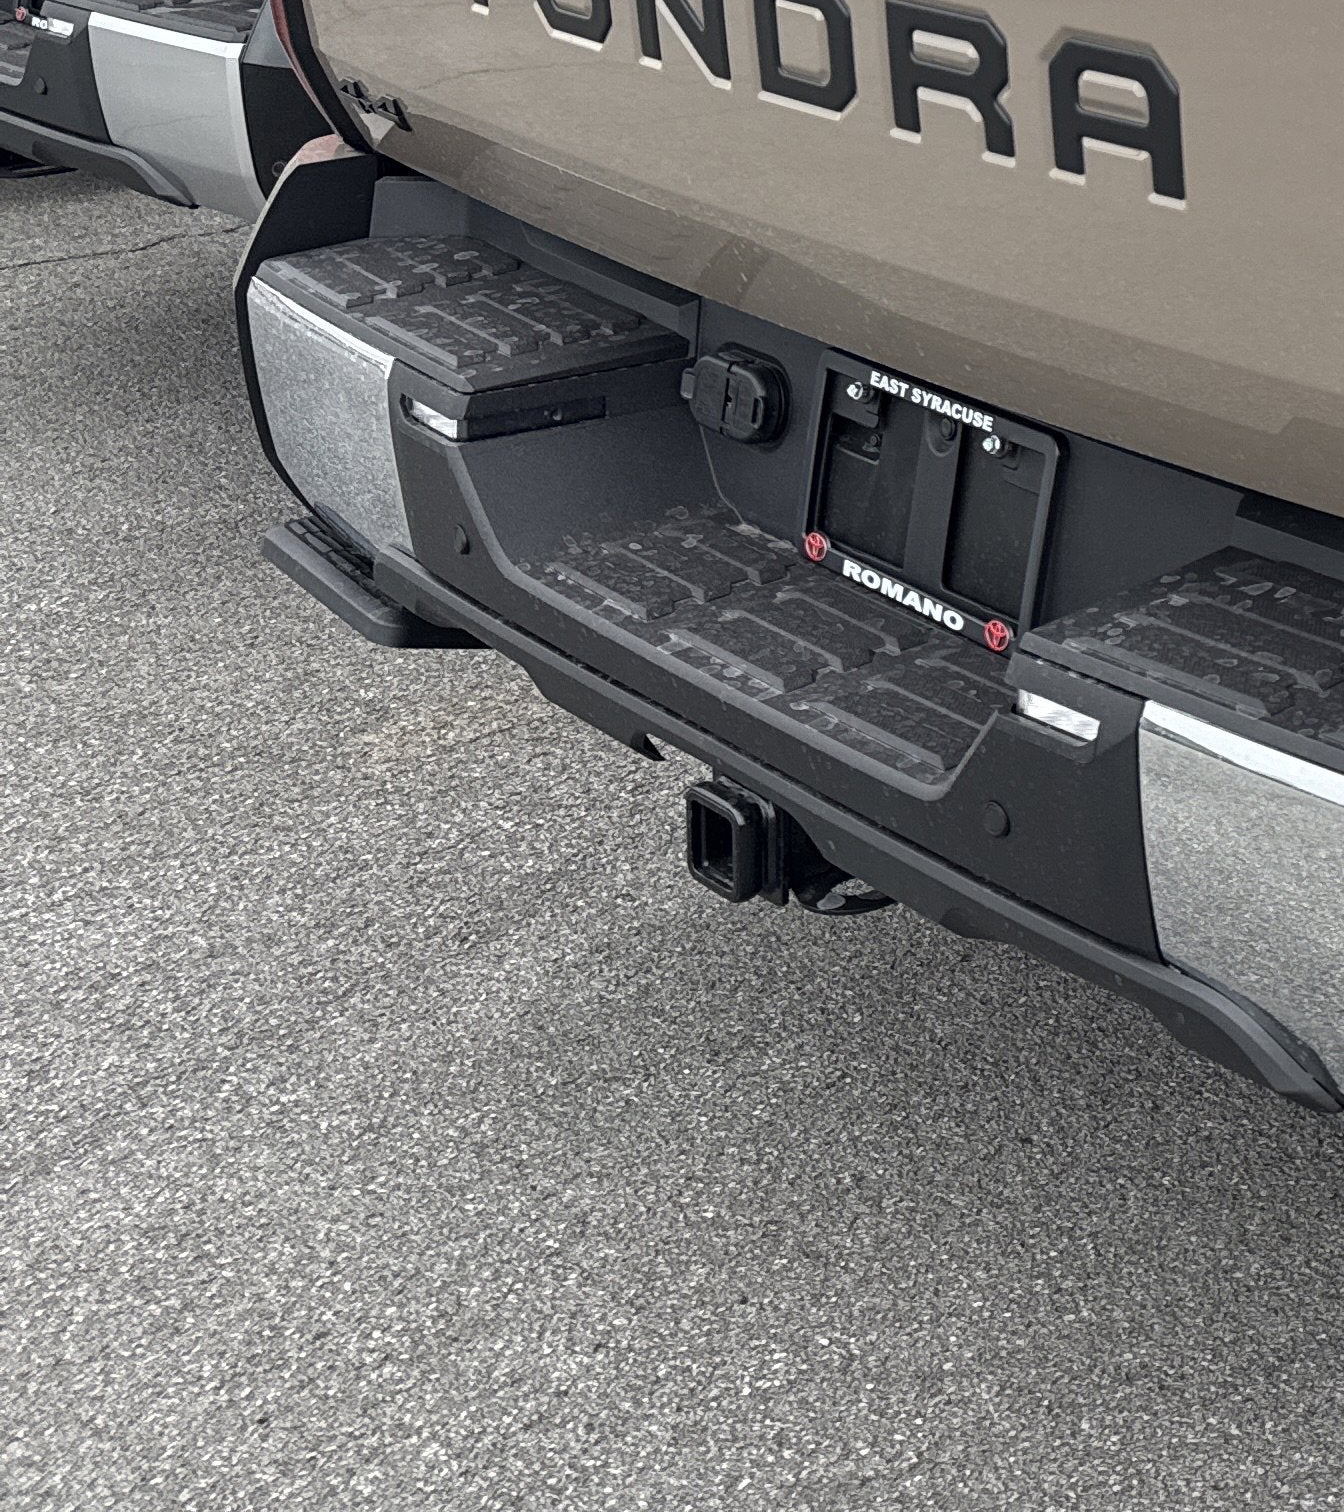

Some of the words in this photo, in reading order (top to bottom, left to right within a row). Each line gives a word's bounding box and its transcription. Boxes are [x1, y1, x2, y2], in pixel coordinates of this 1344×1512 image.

[870, 370, 909, 398] EAST
[911, 387, 994, 433] SYRACUSE
[842, 559, 965, 632] ROMANO
